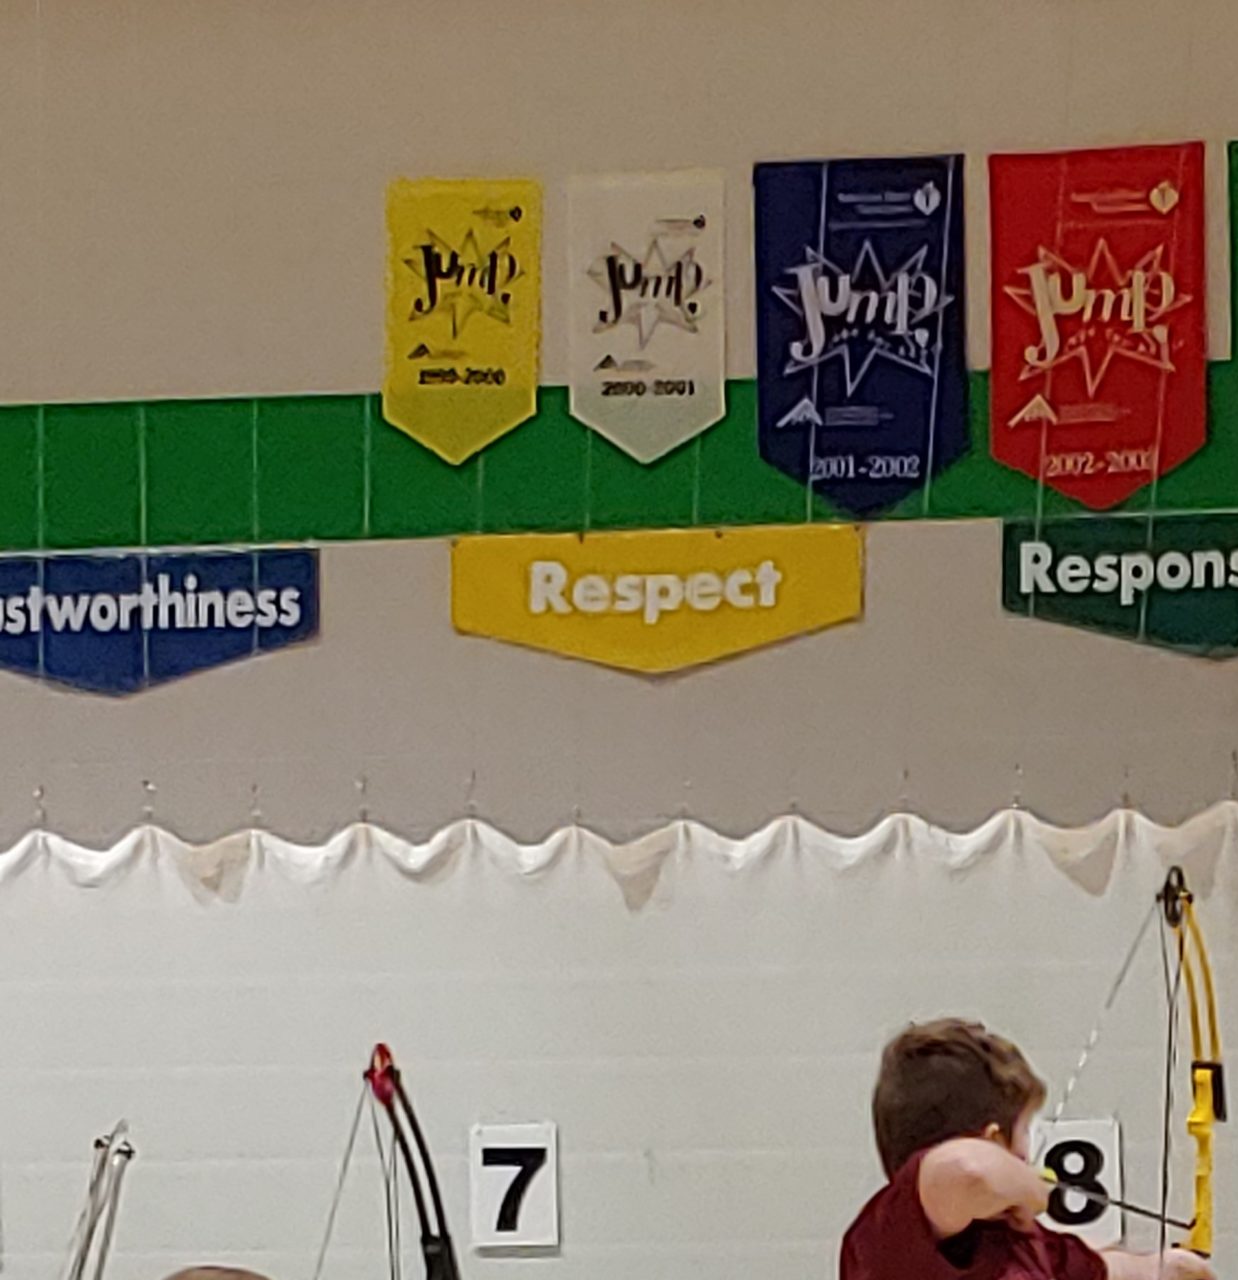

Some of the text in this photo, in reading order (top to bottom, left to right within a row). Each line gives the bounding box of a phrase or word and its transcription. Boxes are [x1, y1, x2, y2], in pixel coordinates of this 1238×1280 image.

[810, 455, 920, 480] 2001-2002
[0, 572, 301, 634] stworthiness
[529, 560, 782, 624] Respect
[482, 1148, 547, 1232] 7
[1044, 1140, 1109, 1225] 8
